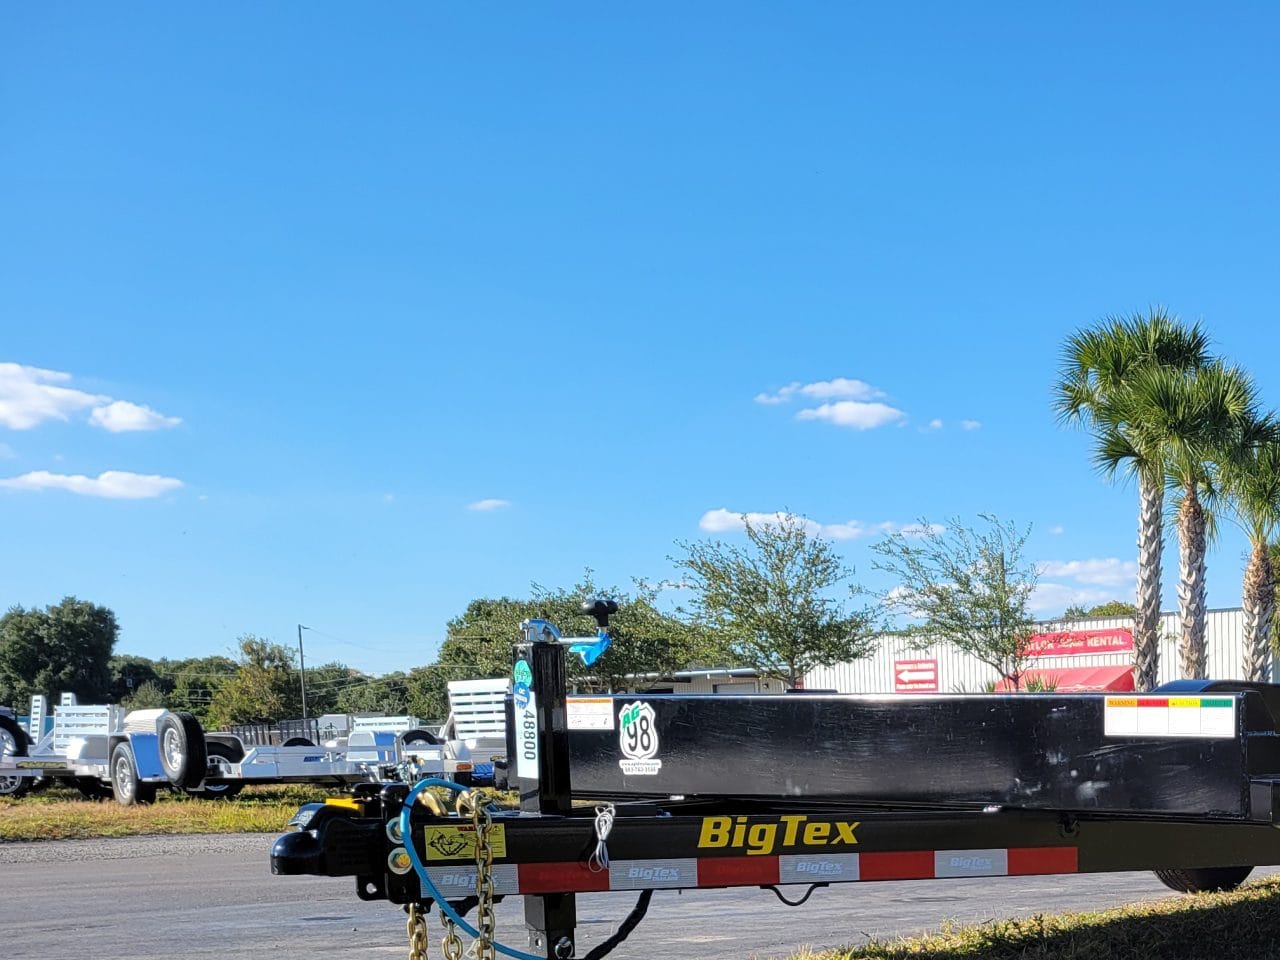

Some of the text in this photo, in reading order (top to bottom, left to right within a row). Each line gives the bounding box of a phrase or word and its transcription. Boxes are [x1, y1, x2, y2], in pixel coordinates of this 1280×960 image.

[1087, 636, 1125, 647] RENTAL
[623, 704, 640, 729] AG
[523, 710, 537, 760] 48800
[627, 715, 651, 752] 98
[697, 815, 861, 855] BigTex
[796, 861, 843, 873] BigTex
[950, 856, 992, 869] BigTex
[628, 867, 679, 880] BigTex
